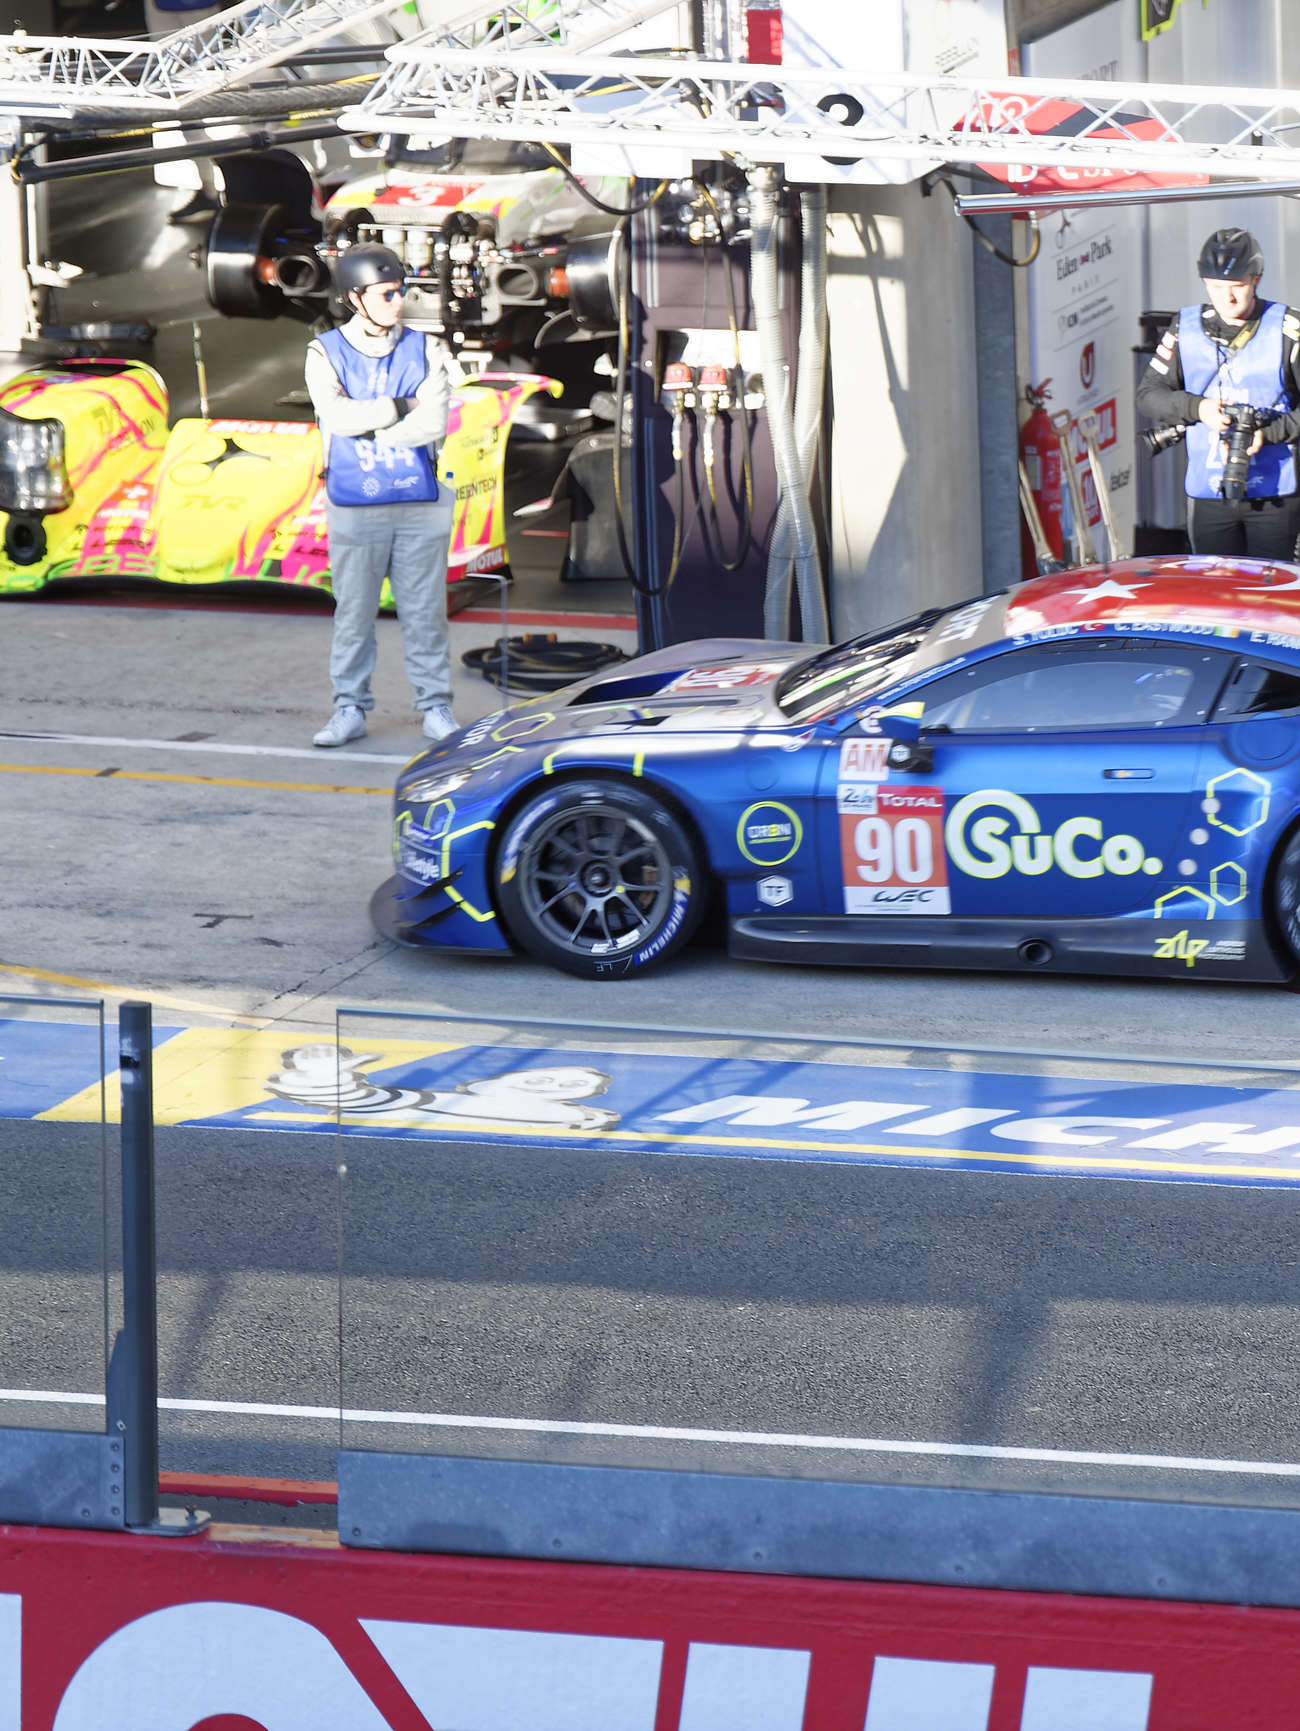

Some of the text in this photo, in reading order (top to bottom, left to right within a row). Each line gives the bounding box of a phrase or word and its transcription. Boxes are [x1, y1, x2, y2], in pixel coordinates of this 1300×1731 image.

[465, 547, 504, 573] MOTUL
[843, 744, 886, 772] AM
[877, 793, 943, 808] TOTAL
[946, 789, 1164, 879] SuCo.
[854, 816, 934, 884] 90
[872, 889, 935, 903] WEC
[638, 901, 687, 963] MICHELIN
